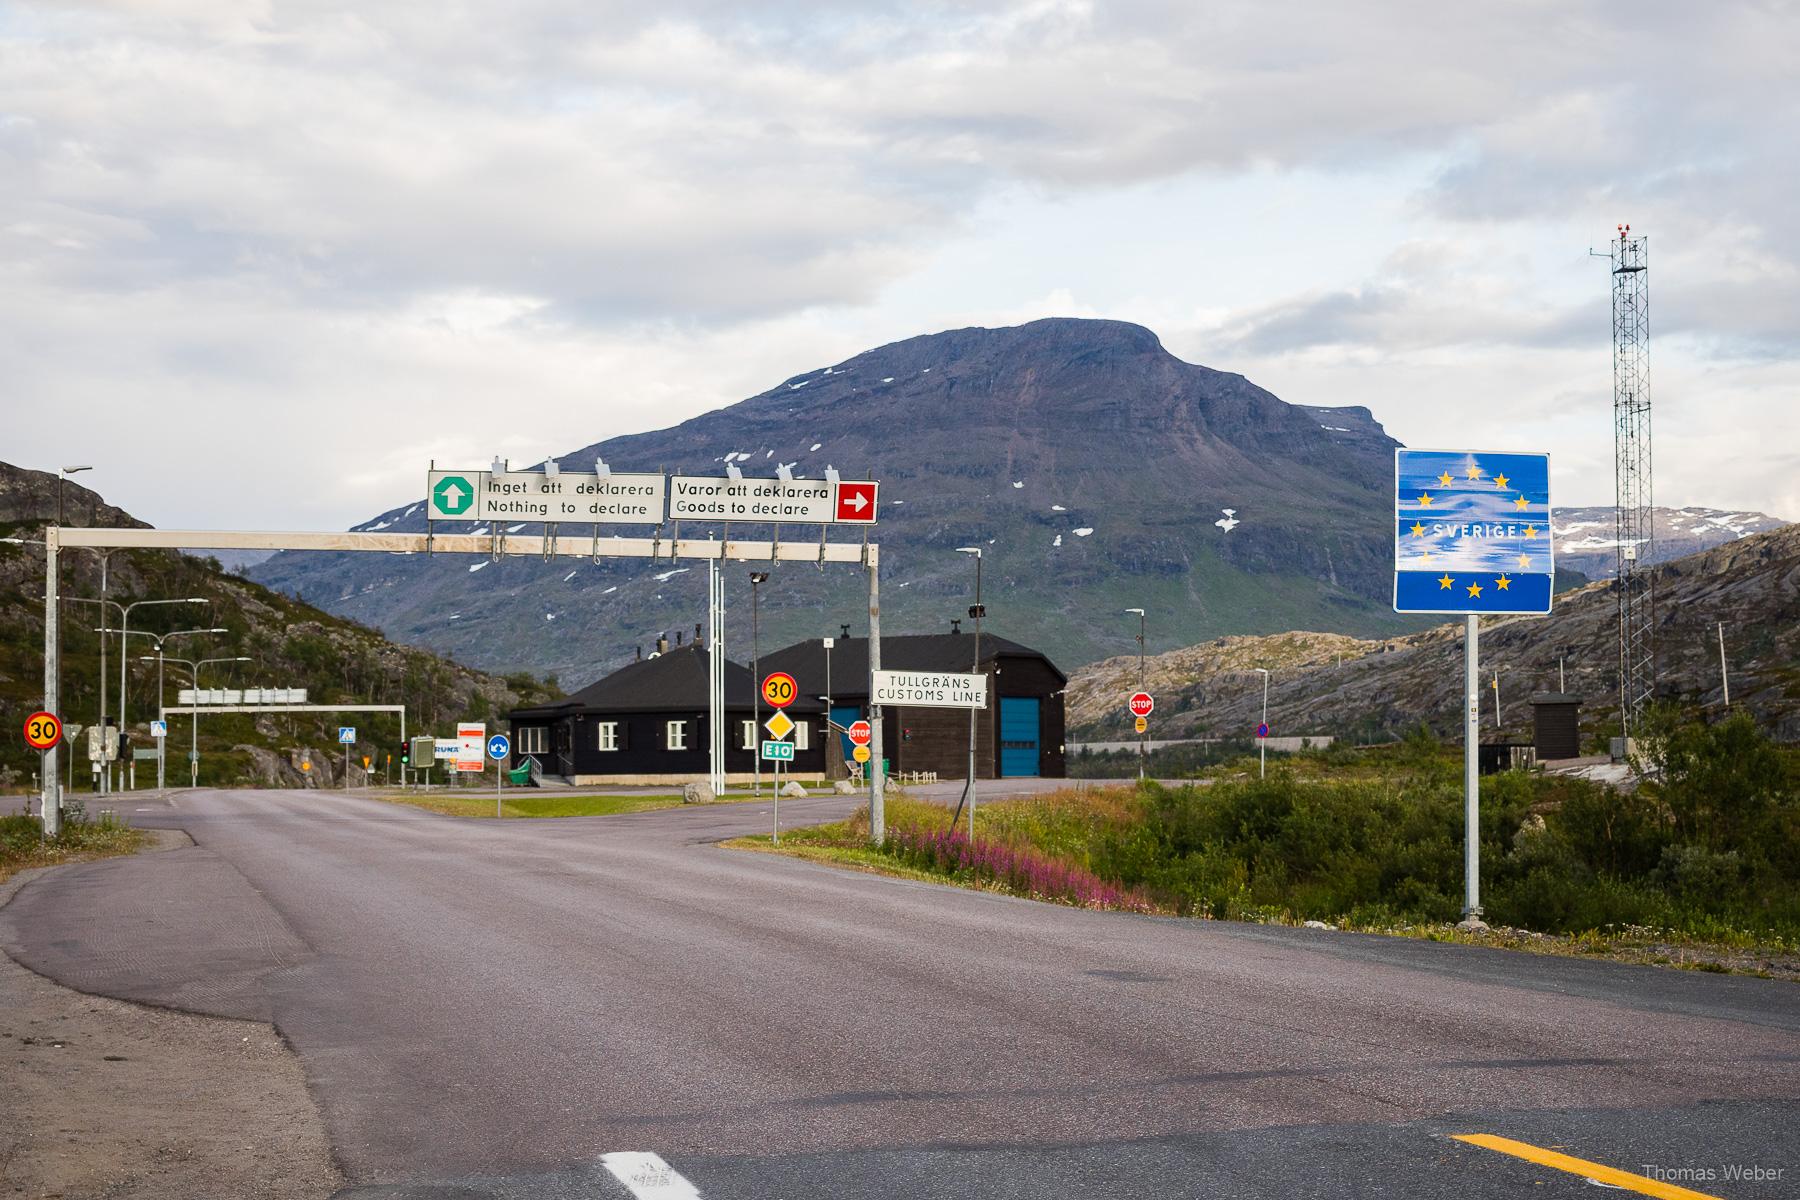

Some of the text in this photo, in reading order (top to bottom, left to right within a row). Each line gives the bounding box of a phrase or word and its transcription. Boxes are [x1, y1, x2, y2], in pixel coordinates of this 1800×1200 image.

[488, 481, 654, 496] Inget att deklarera
[677, 482, 828, 499] Varor att deklarera
[488, 500, 647, 516] Nothing to declare
[676, 500, 809, 516] Goods to declare
[1433, 523, 1517, 539] SVERIGE
[768, 681, 791, 699] 30
[890, 675, 971, 689] TULLGRÄNS
[878, 688, 982, 703] CUSTOMS LINE
[1131, 700, 1151, 709] STOP
[30, 721, 56, 740] 30
[766, 745, 791, 757] E10
